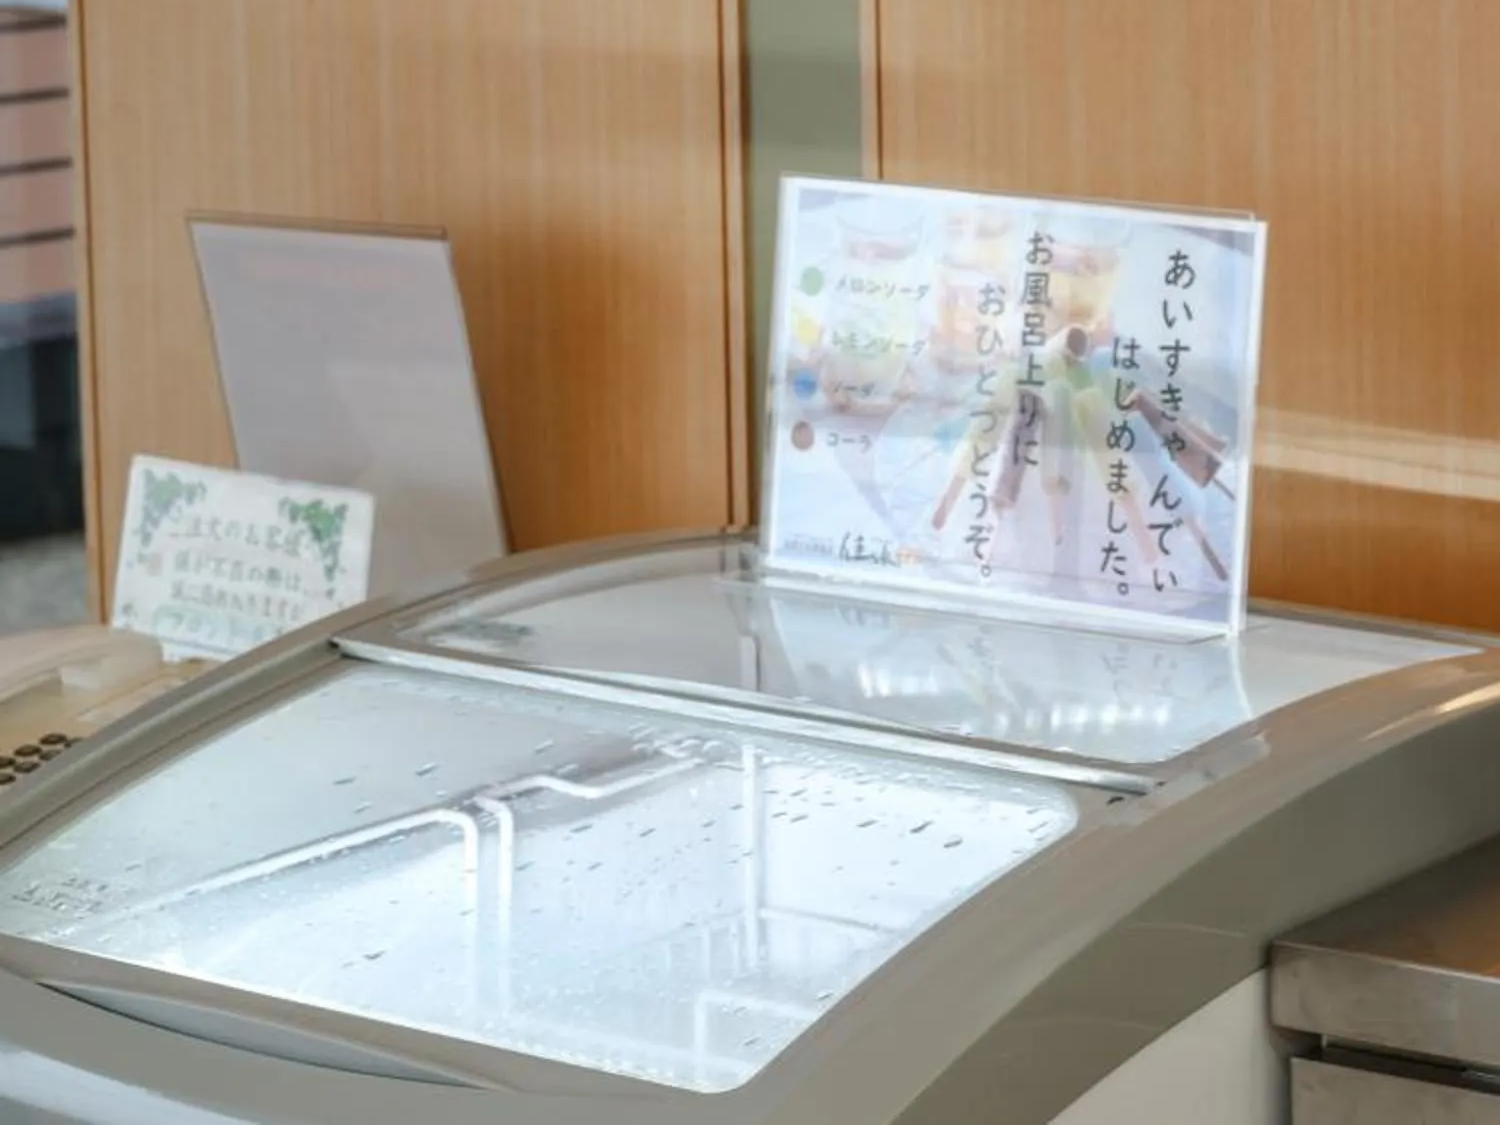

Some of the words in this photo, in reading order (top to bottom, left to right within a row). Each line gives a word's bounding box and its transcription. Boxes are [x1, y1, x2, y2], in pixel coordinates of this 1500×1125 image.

[826, 431, 875, 453] コーラ
[964, 281, 1007, 579] おひとつどうぞ。
[1012, 231, 1054, 467] お風呂上りに
[1100, 336, 1141, 596] はじめました。
